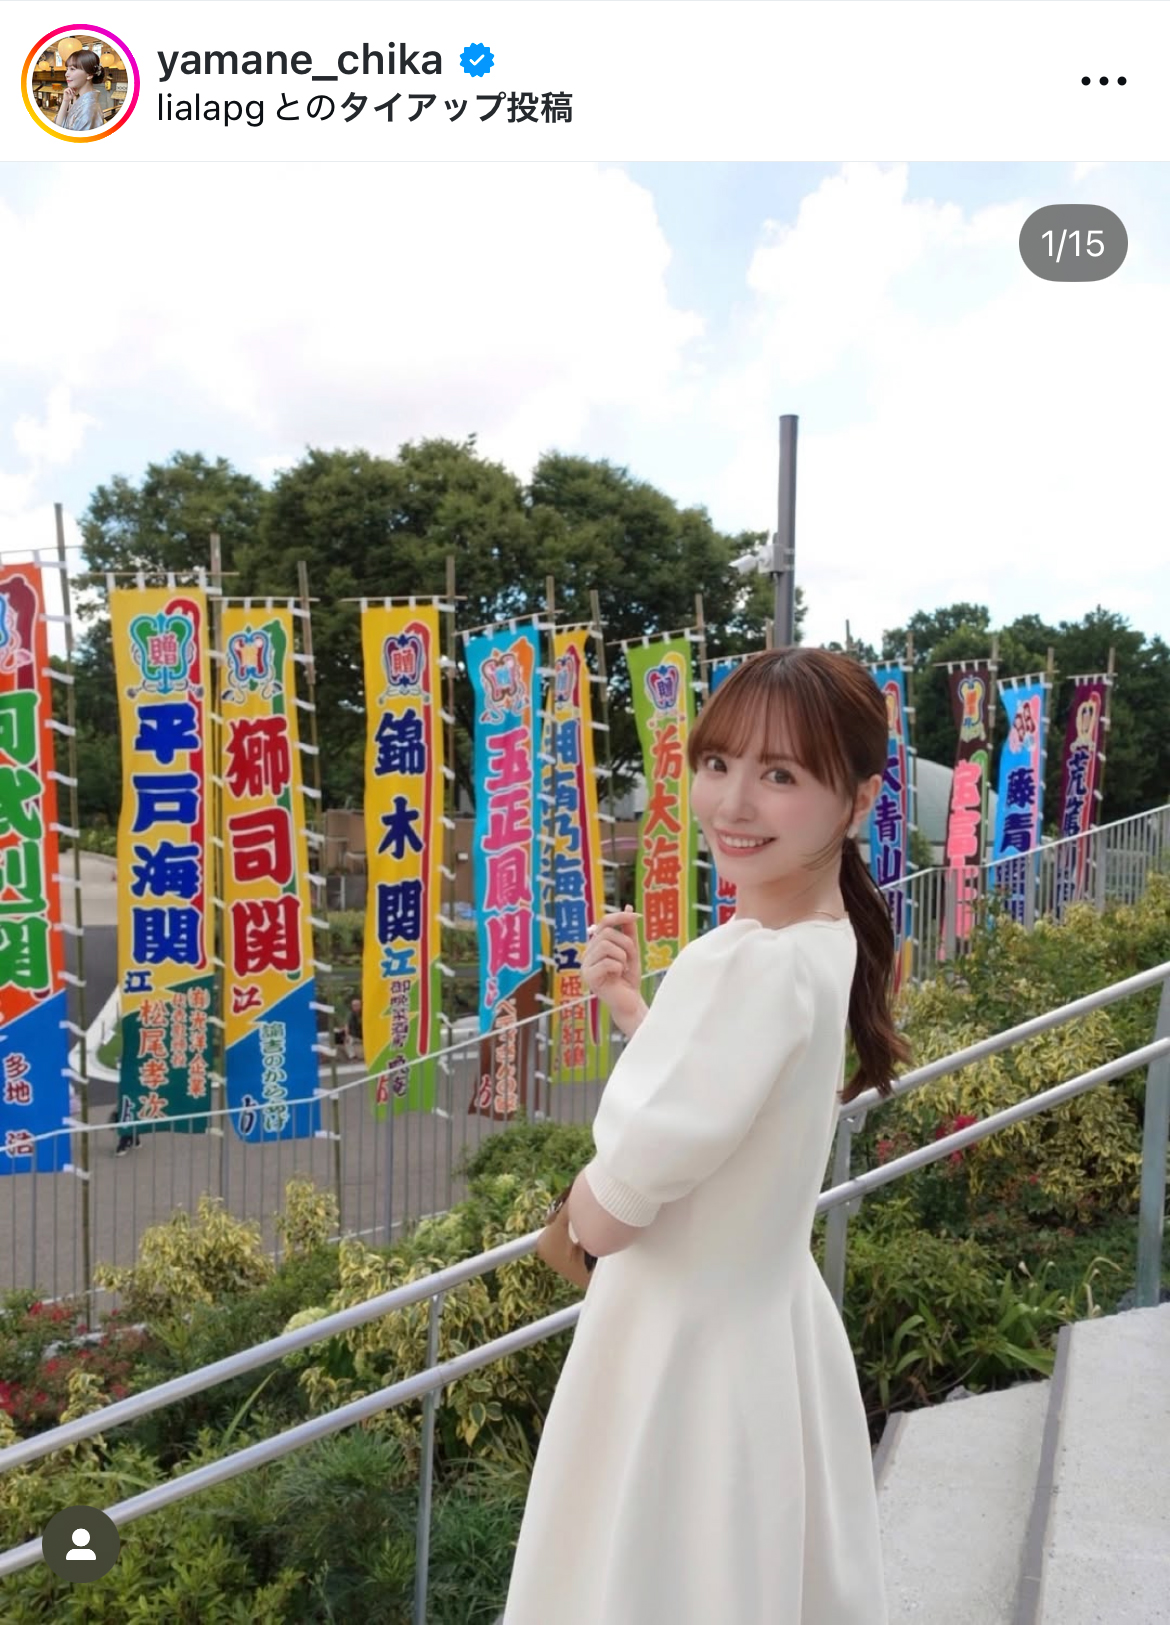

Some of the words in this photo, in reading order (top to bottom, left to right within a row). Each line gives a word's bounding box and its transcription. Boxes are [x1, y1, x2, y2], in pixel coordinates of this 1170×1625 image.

[226, 715, 301, 980] 獅司関
[374, 708, 426, 944] 錦木関
